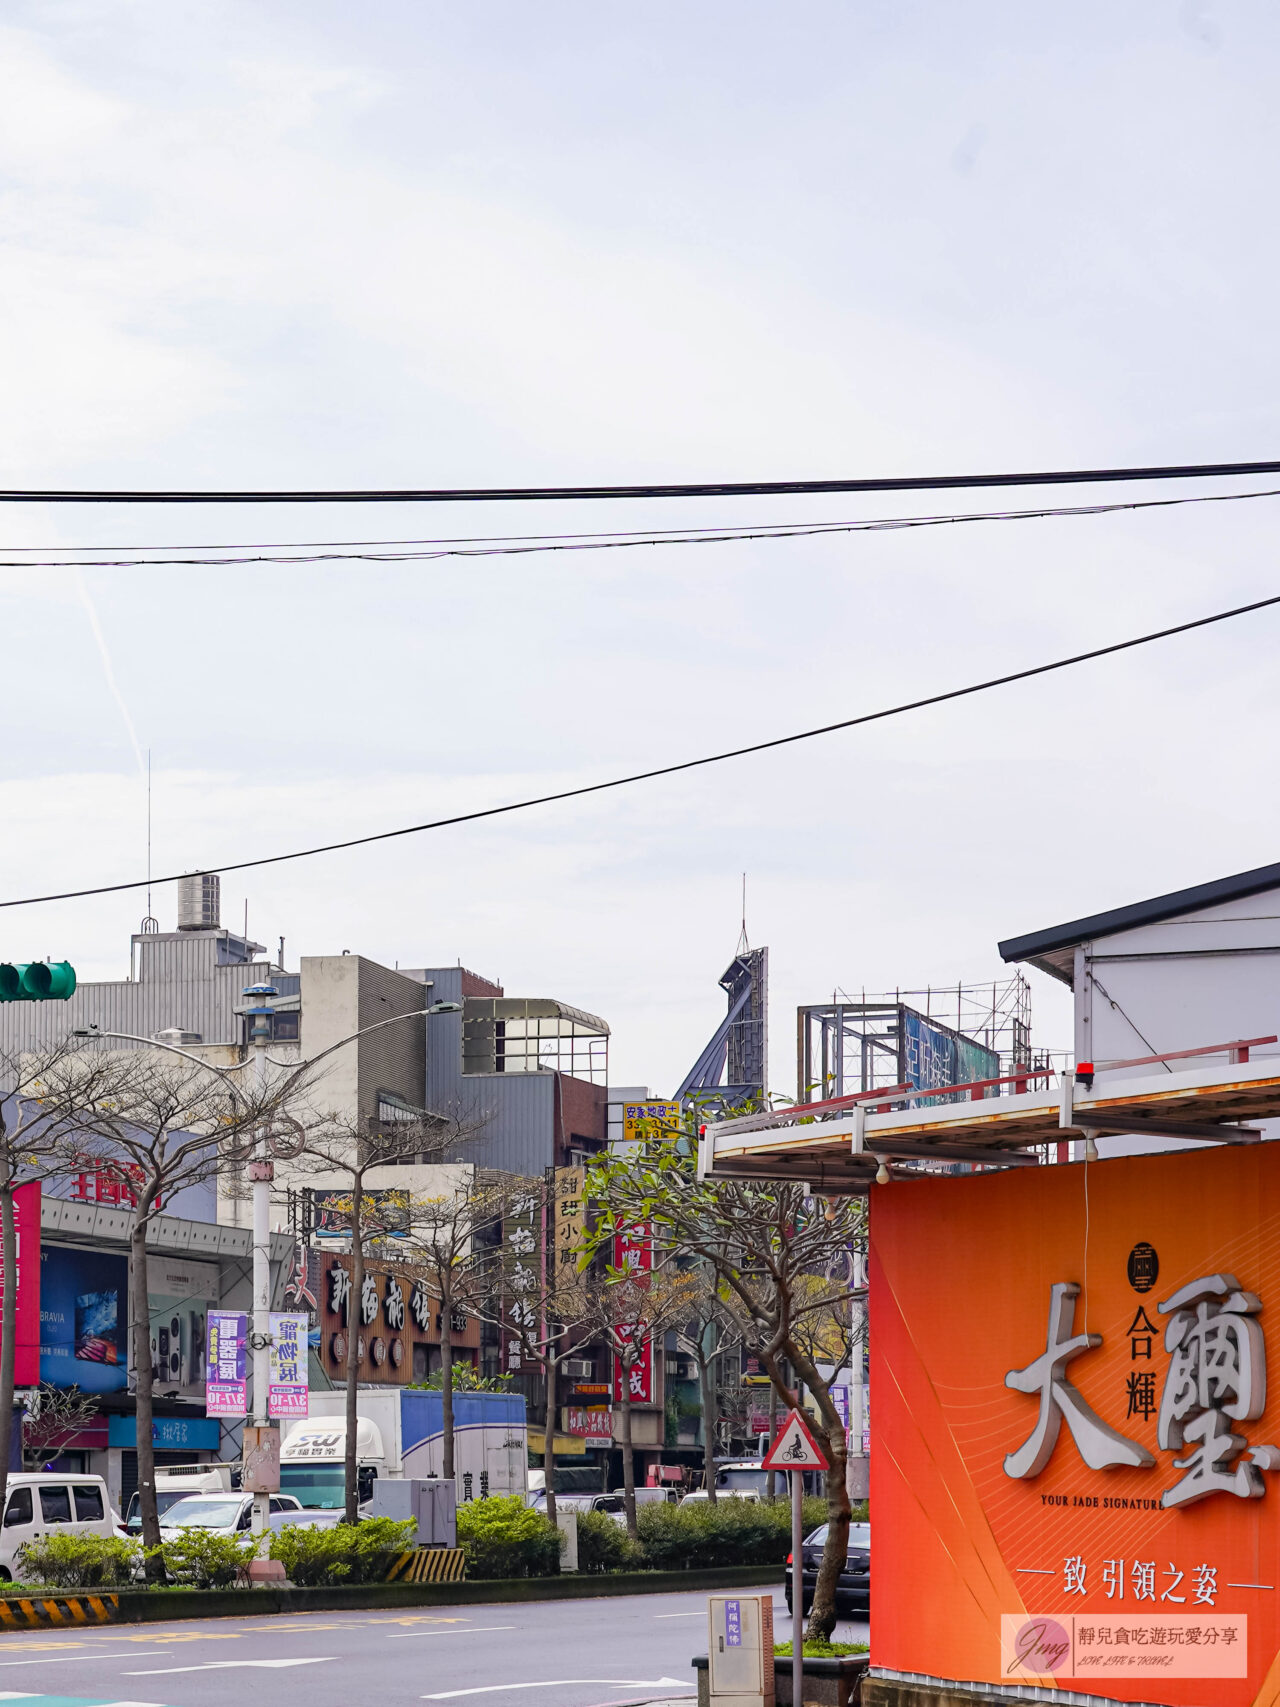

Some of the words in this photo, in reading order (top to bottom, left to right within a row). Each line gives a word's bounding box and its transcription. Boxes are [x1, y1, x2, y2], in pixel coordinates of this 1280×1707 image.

[1126, 1305, 1159, 1421] 合輝
[1041, 1495, 1068, 1506] YOUR
[1073, 1496, 1099, 1508] JADE
[1103, 1498, 1165, 1510] SIGNATURE
[1063, 1556, 1088, 1596] 致
[1102, 1559, 1218, 1606] 引領之姿
